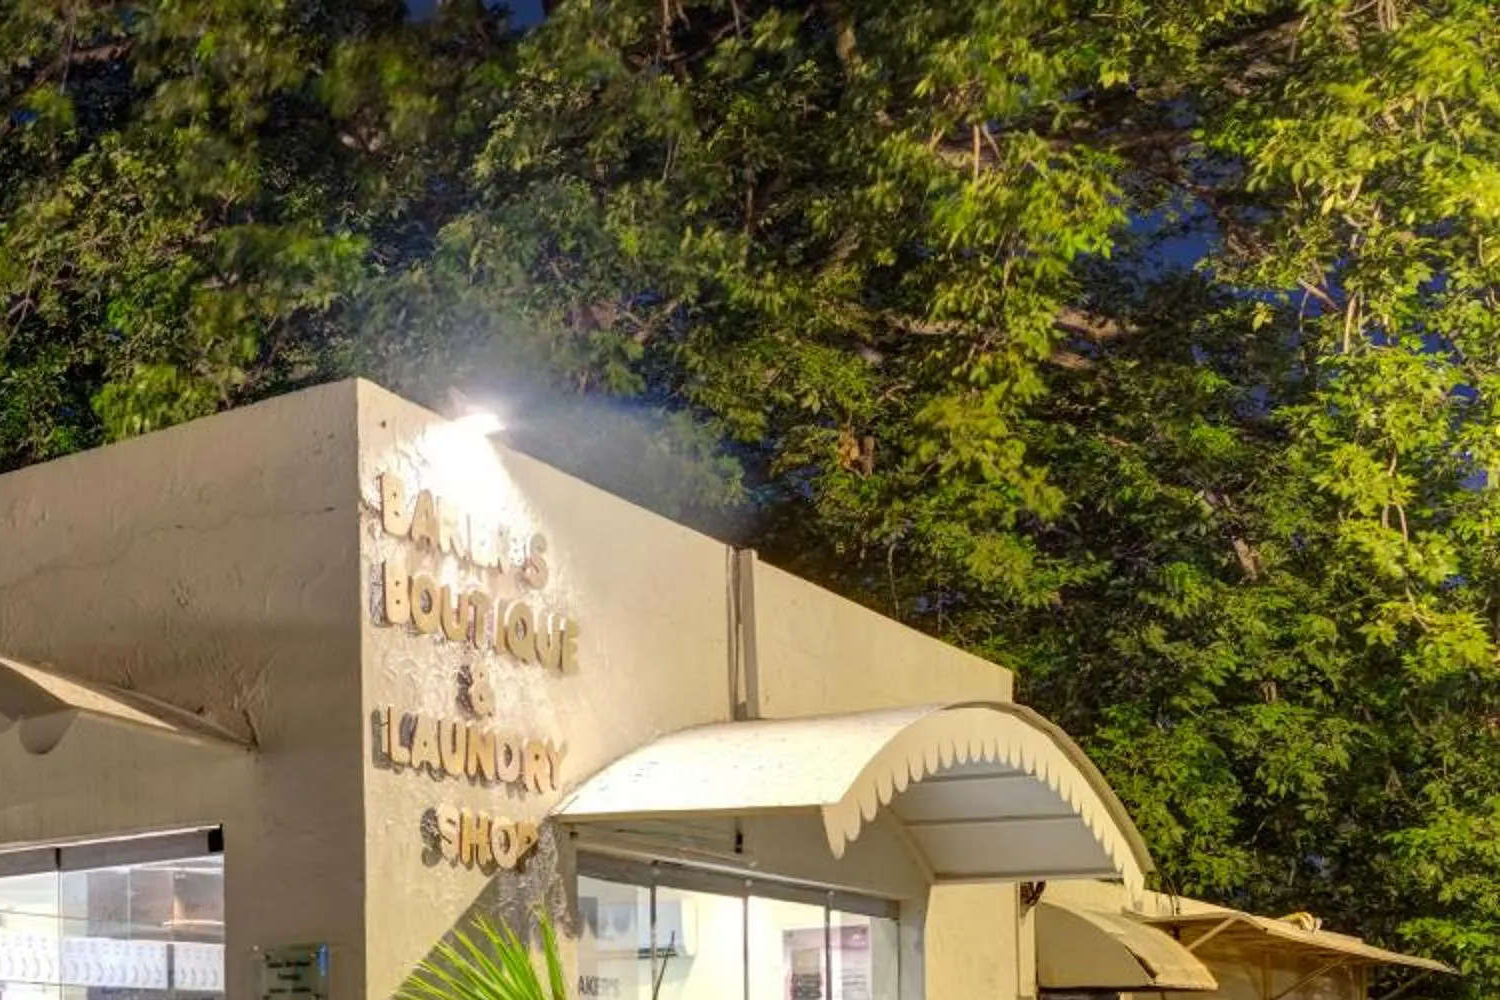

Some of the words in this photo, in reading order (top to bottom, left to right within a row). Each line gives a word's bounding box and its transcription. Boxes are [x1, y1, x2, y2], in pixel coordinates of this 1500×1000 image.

[381, 559, 580, 673] BOUTIQUE
[386, 704, 568, 794] LAUNDRY
[437, 803, 540, 872] SHOP
